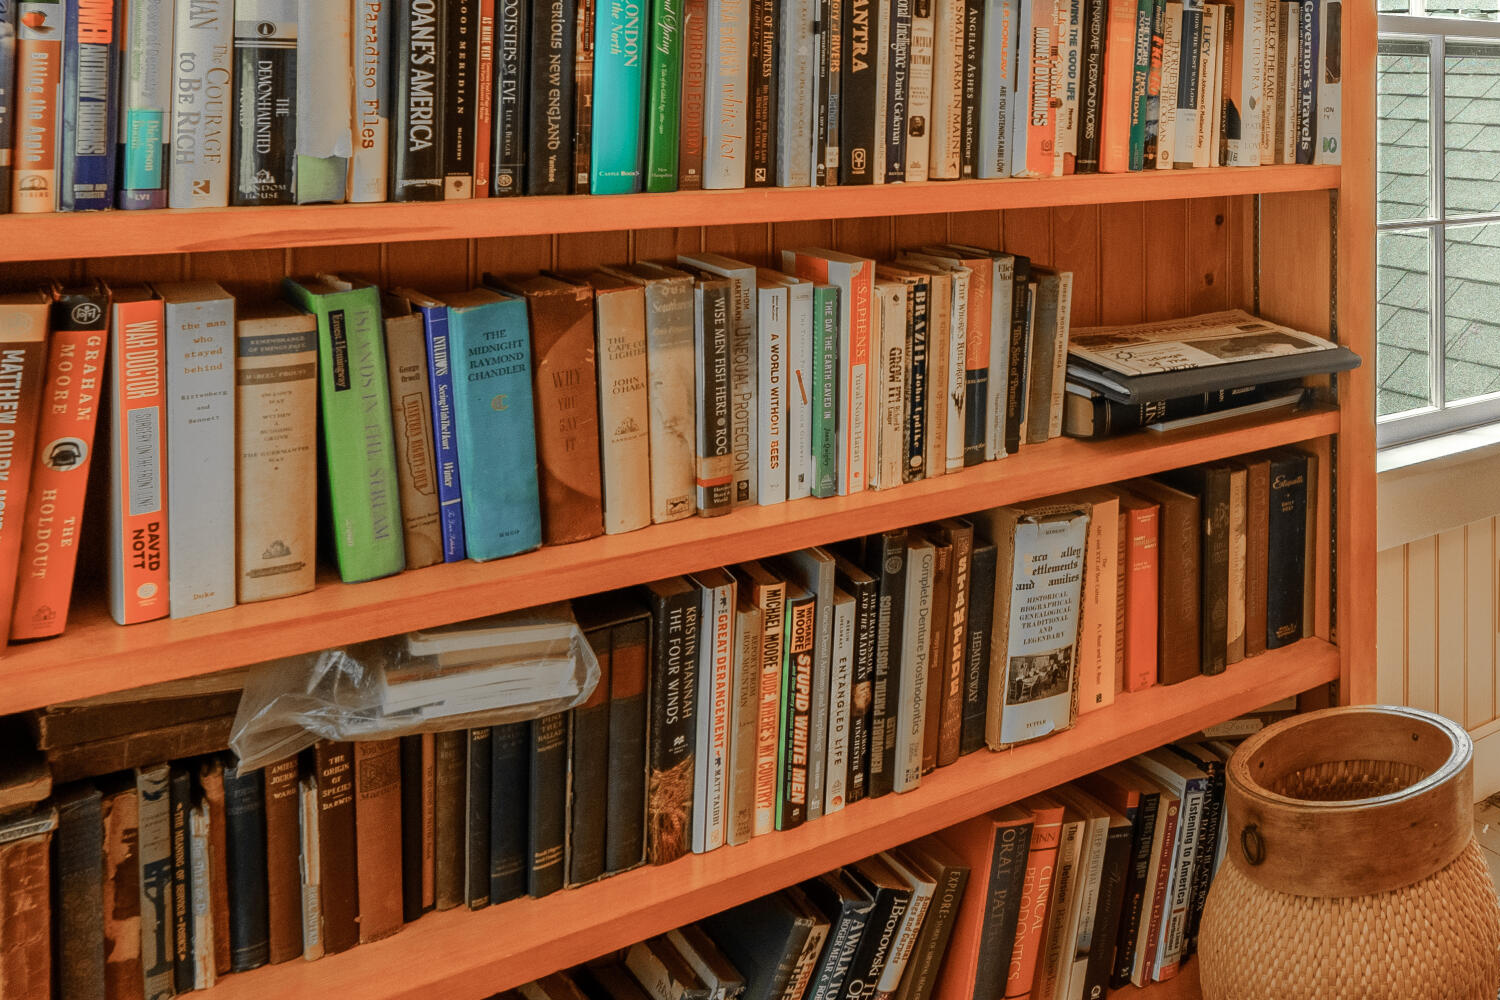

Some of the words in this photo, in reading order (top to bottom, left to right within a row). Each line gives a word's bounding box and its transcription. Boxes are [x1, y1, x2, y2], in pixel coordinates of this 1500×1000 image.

[611, 2, 623, 20] the
[363, 1, 383, 89] Paradiso
[609, 22, 623, 56] North
[1202, 24, 1211, 57] LUCY
[1303, 0, 1315, 88] Governor's
[456, 41, 468, 115] MERIDIAN
[548, 54, 561, 86] NEW
[408, 68, 435, 152] AMERICA
[502, 80, 516, 105] EVE
[361, 98, 380, 149] Files
[545, 88, 562, 150] ENGLAND
[1301, 90, 1313, 151] Travels
[714, 297, 726, 325] WISE
[824, 300, 833, 316] THE
[824, 318, 833, 333] DAY
[125, 319, 159, 350] WAR
[468, 339, 524, 357] MIDNIGHT
[483, 329, 507, 341] THE
[714, 328, 726, 354] MEN
[770, 333, 779, 341] A
[824, 335, 833, 351] THE
[52, 344, 76, 416] MOORE
[76, 335, 102, 422] GRAHAM
[125, 349, 160, 400] DOCTOR
[467, 363, 526, 382] CHANDLER
[469, 352, 524, 370] RAYMOND
[715, 358, 726, 383] FISH
[770, 344, 780, 384] WORLD
[823, 354, 833, 380] EARTH
[715, 386, 727, 417] HERE
[769, 387, 779, 437] WITHOUT
[823, 382, 832, 408] CAVED
[823, 411, 832, 419] IN
[770, 440, 779, 470] BEES
[31, 488, 58, 580] HOLDOUT
[59, 515, 76, 548] THE
[132, 528, 146, 570] NOTT
[146, 521, 160, 572] DAVID
[918, 553, 933, 606] Complete
[668, 607, 682, 634] THE
[764, 588, 782, 631] MICHAEL
[683, 606, 697, 655] KRISTIN
[717, 614, 728, 653] GREAT
[916, 607, 930, 652] Denture
[667, 637, 681, 676] FOUR
[763, 632, 781, 670] MOORE
[857, 632, 868, 680] MADMAN
[968, 630, 983, 703] HEMINGWAY
[665, 678, 680, 726] WINDS
[681, 659, 695, 719] HANNAH
[795, 654, 811, 711] STUPID
[835, 656, 848, 733] ENTANGLED
[911, 653, 926, 736] Prosthodontics
[713, 656, 728, 750] DERANGEMENT
[328, 754, 345, 765] THE
[792, 715, 809, 765] WHITE
[833, 738, 844, 766] LIFE
[323, 762, 350, 777] ORIGIN
[790, 767, 806, 805] MEN
[1183, 796, 1202, 845] Listening
[1182, 846, 1193, 858] to
[1030, 865, 1053, 936] CLINICAL
[1175, 860, 1193, 905] America
